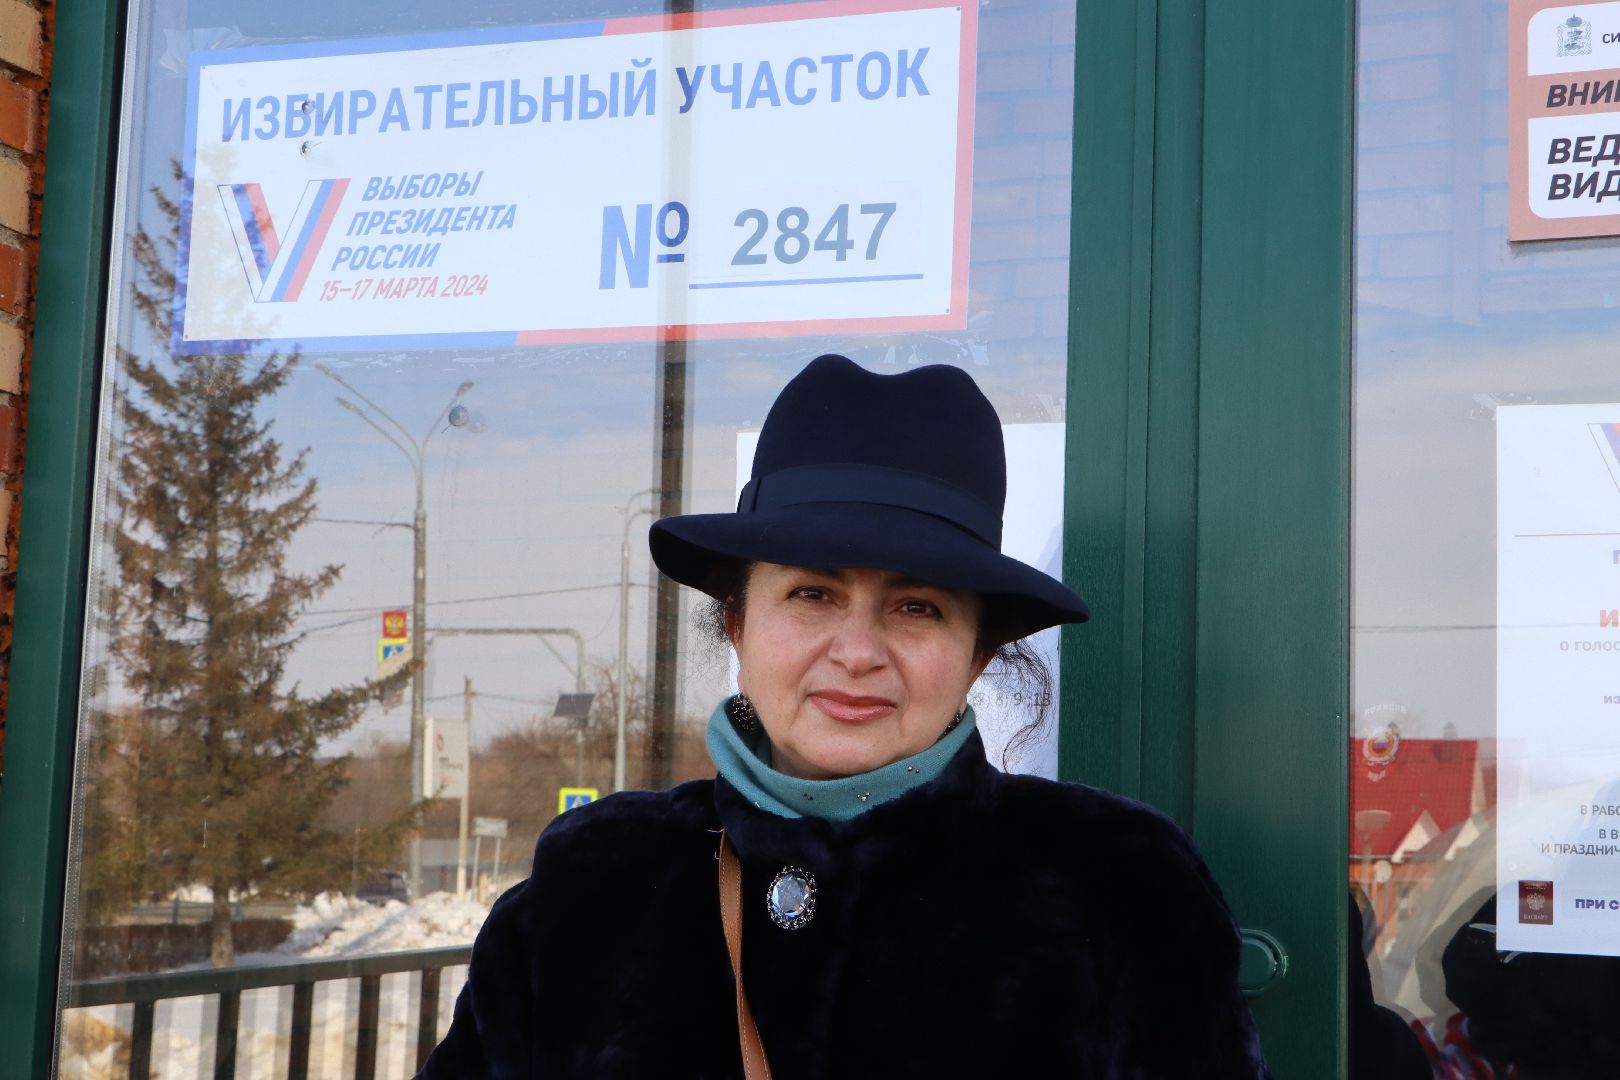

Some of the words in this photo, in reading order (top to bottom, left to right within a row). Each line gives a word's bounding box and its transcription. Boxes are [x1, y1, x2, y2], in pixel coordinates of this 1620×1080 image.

[221, 57, 656, 143] ИЗБИРАТЕЛЬНЫЙ
[675, 47, 931, 114] УЧАСТОК
[1547, 133, 1620, 167] ВЕД
[361, 170, 484, 202] ВЫБОРЫ
[1547, 170, 1620, 203] ВИД
[346, 204, 517, 236] ПРЕЗИДЕНТА
[730, 202, 897, 266] 2847
[331, 242, 441, 272] РОССИИ
[372, 275, 439, 300] МАРТА
[440, 273, 488, 298] 2024
[1600, 609, 1620, 628] И
[1541, 842, 1550, 853] И
[1599, 828, 1607, 839] В
[1611, 829, 1620, 839] В
[1575, 898, 1605, 909] ПРИ
